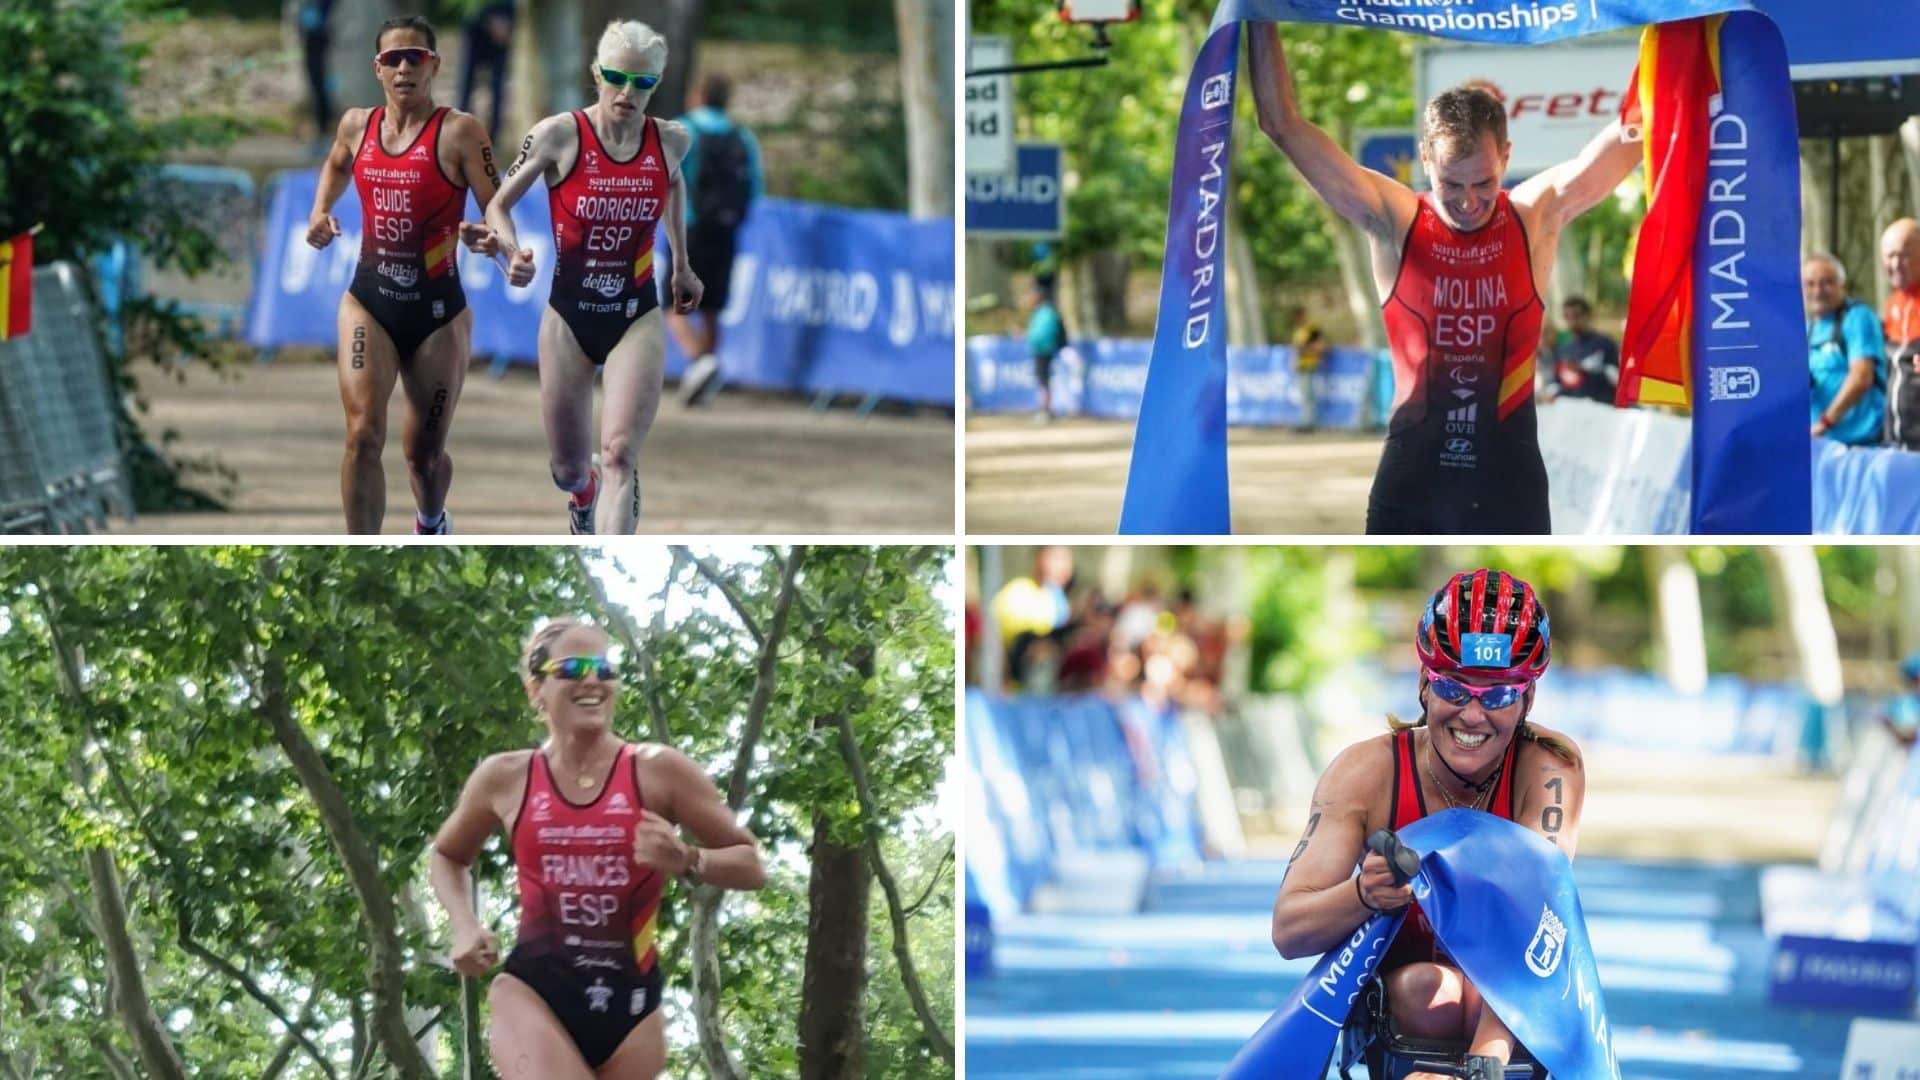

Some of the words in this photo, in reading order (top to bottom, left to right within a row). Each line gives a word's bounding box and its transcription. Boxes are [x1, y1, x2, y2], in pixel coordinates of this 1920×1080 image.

[1336, 2, 1578, 32] Championships
[373, 187, 412, 213] GUIDE
[576, 196, 660, 221] RODRIGUEZ
[374, 215, 413, 242] ESP
[1709, 114, 1751, 330] MADRID
[587, 226, 632, 252] ESP
[1185, 141, 1224, 349] MADRID
[1433, 274, 1508, 310] MOLINA
[1435, 314, 1496, 347] ESP
[352, 326, 365, 369] 606
[1445, 423, 1476, 434] OVB
[1474, 646, 1502, 661] 101
[541, 854, 631, 888] FRANCES
[559, 892, 620, 927] ESP
